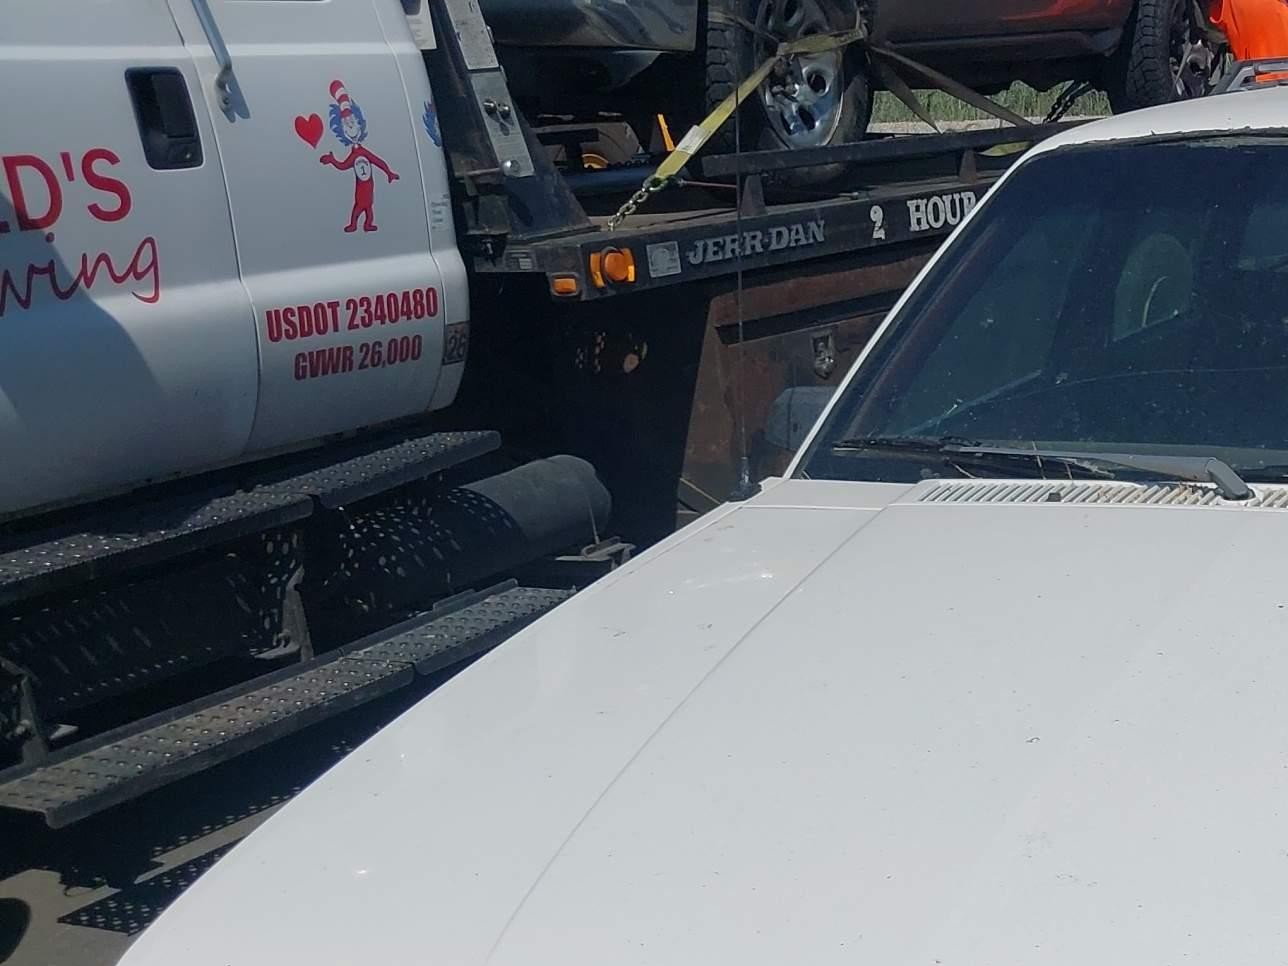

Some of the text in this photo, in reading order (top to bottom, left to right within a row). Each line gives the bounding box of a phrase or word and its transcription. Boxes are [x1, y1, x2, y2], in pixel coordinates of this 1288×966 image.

[0, 148, 132, 231] D'S
[266, 287, 439, 342] USDOT 2340480
[294, 334, 423, 381] GVWR 26,000
